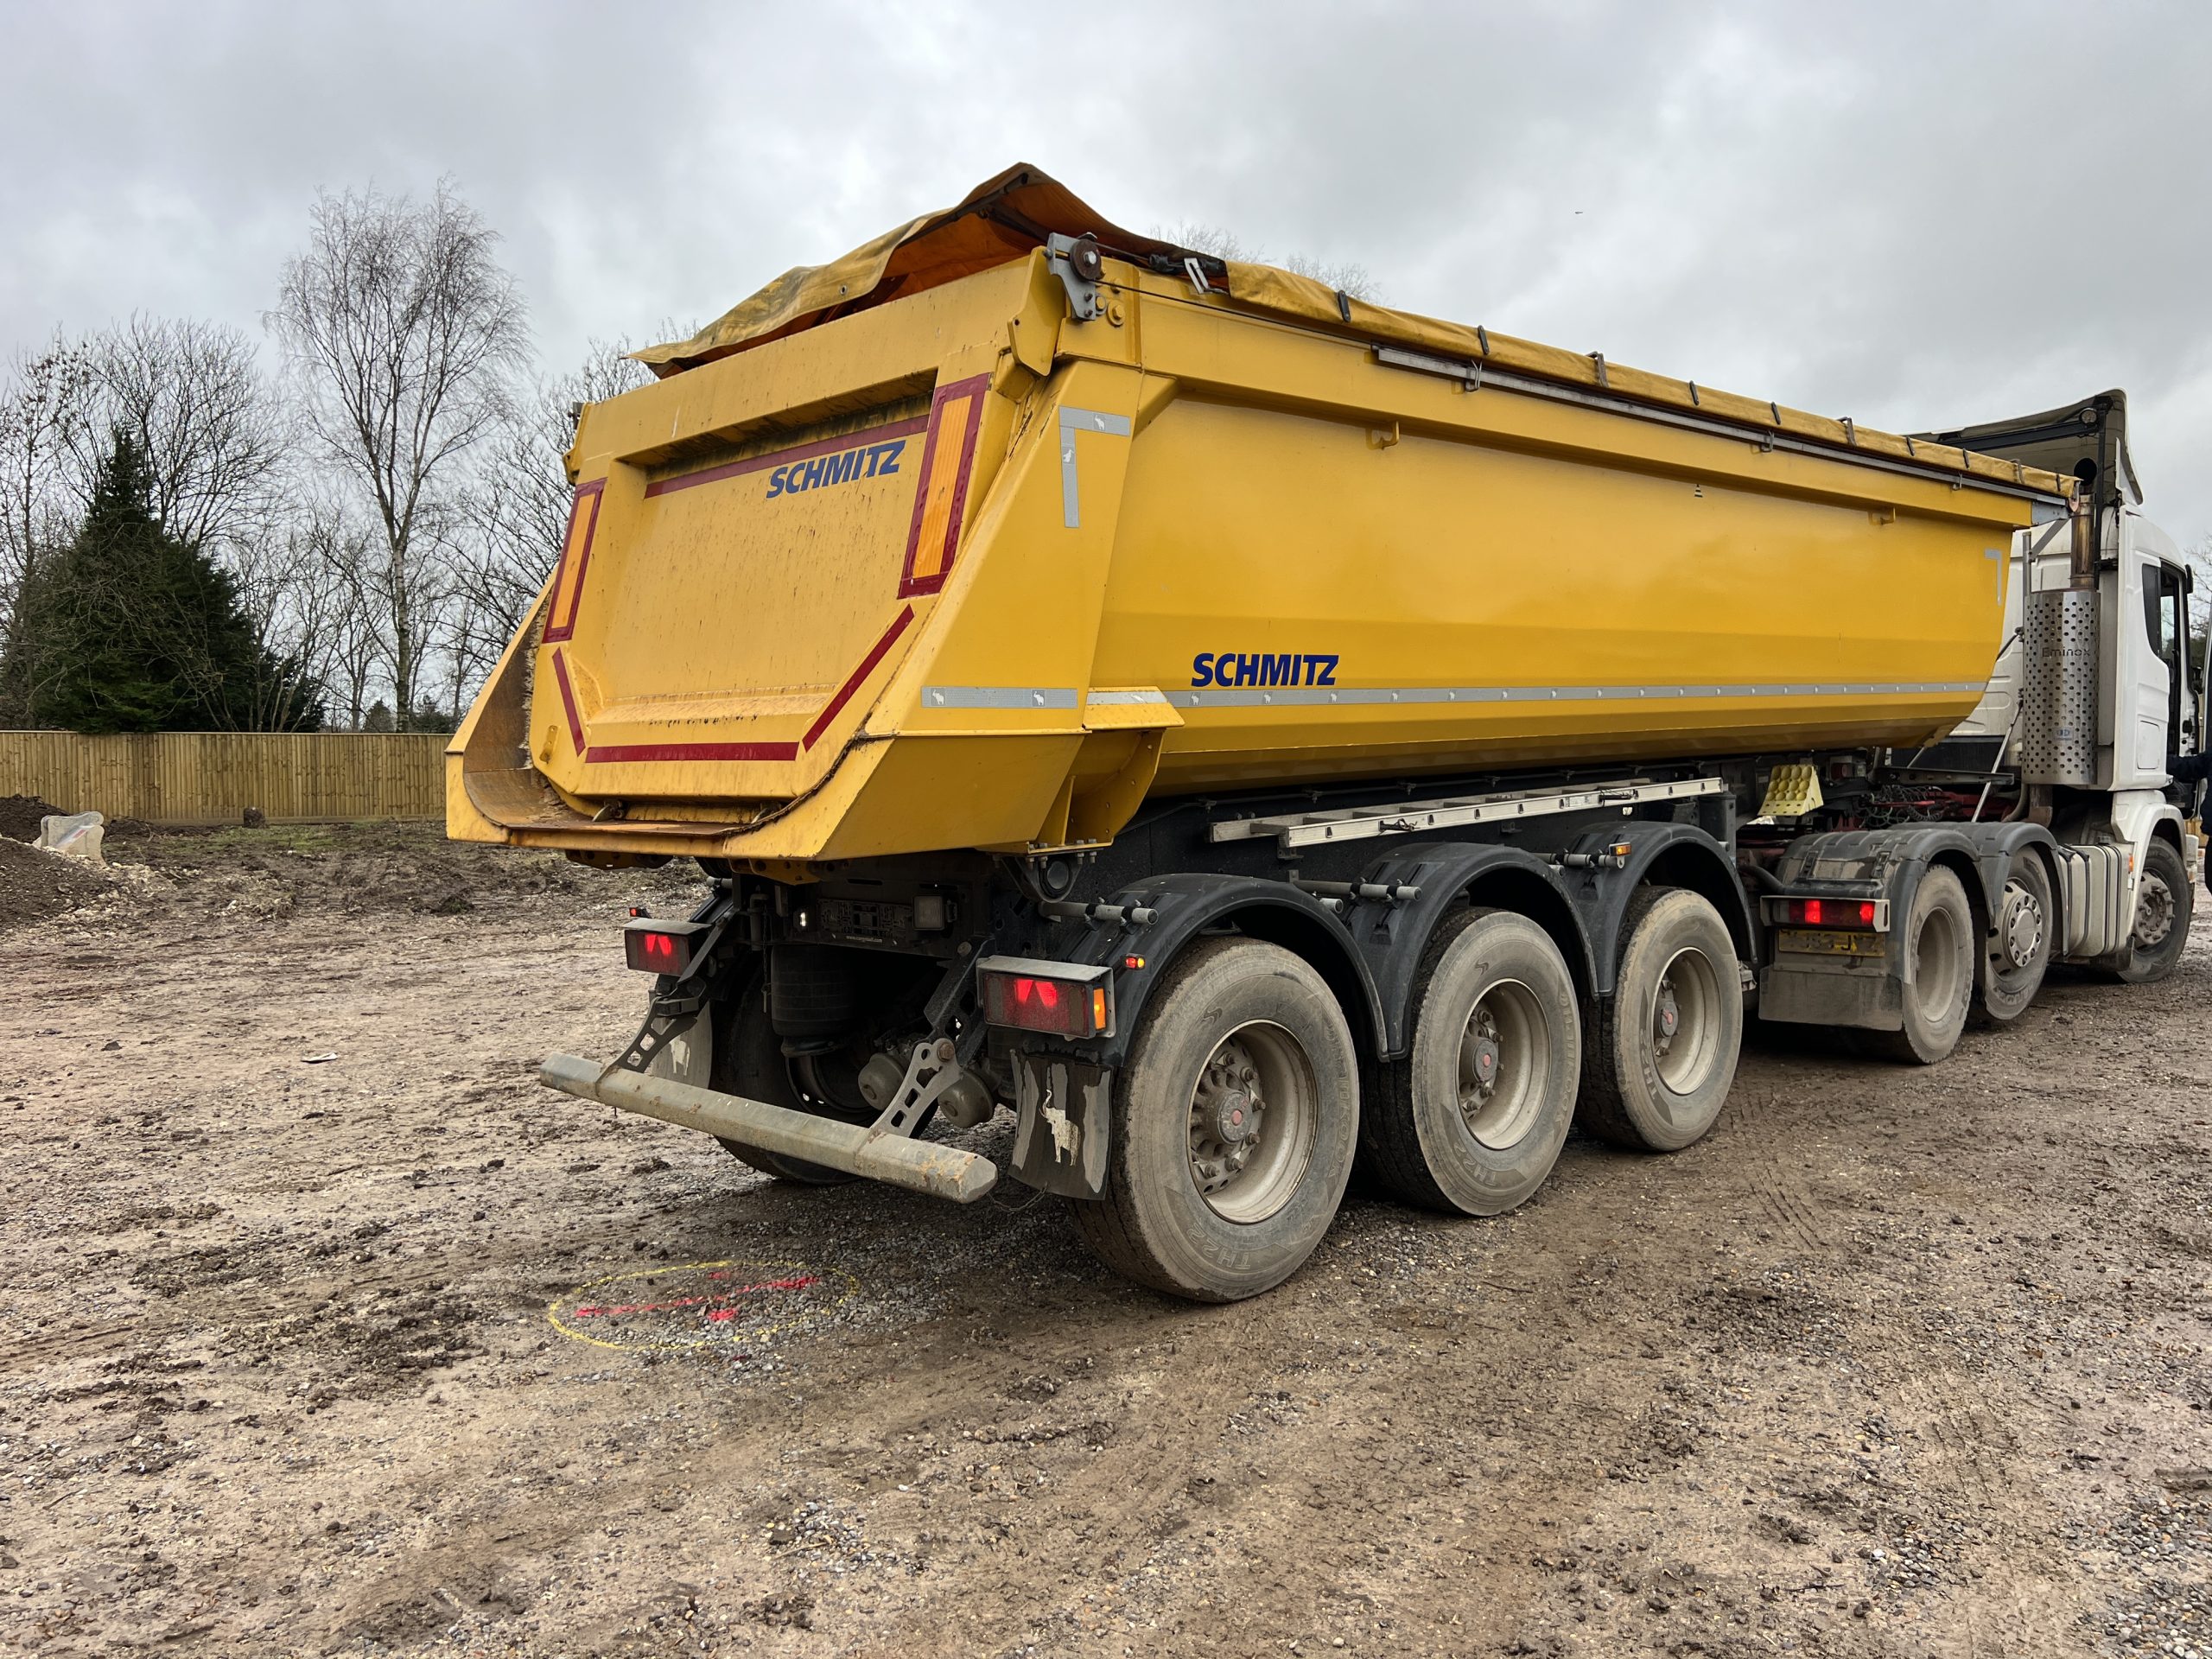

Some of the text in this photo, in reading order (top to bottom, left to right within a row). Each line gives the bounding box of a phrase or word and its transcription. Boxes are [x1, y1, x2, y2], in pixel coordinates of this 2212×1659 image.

[767, 440, 906, 499] SCHMITZ
[1191, 652, 1339, 687] SCHMITZ
[2043, 646, 2089, 658] Eminox
[1454, 1138, 1497, 1186] TH22
[1186, 1222, 1250, 1271] TH22
